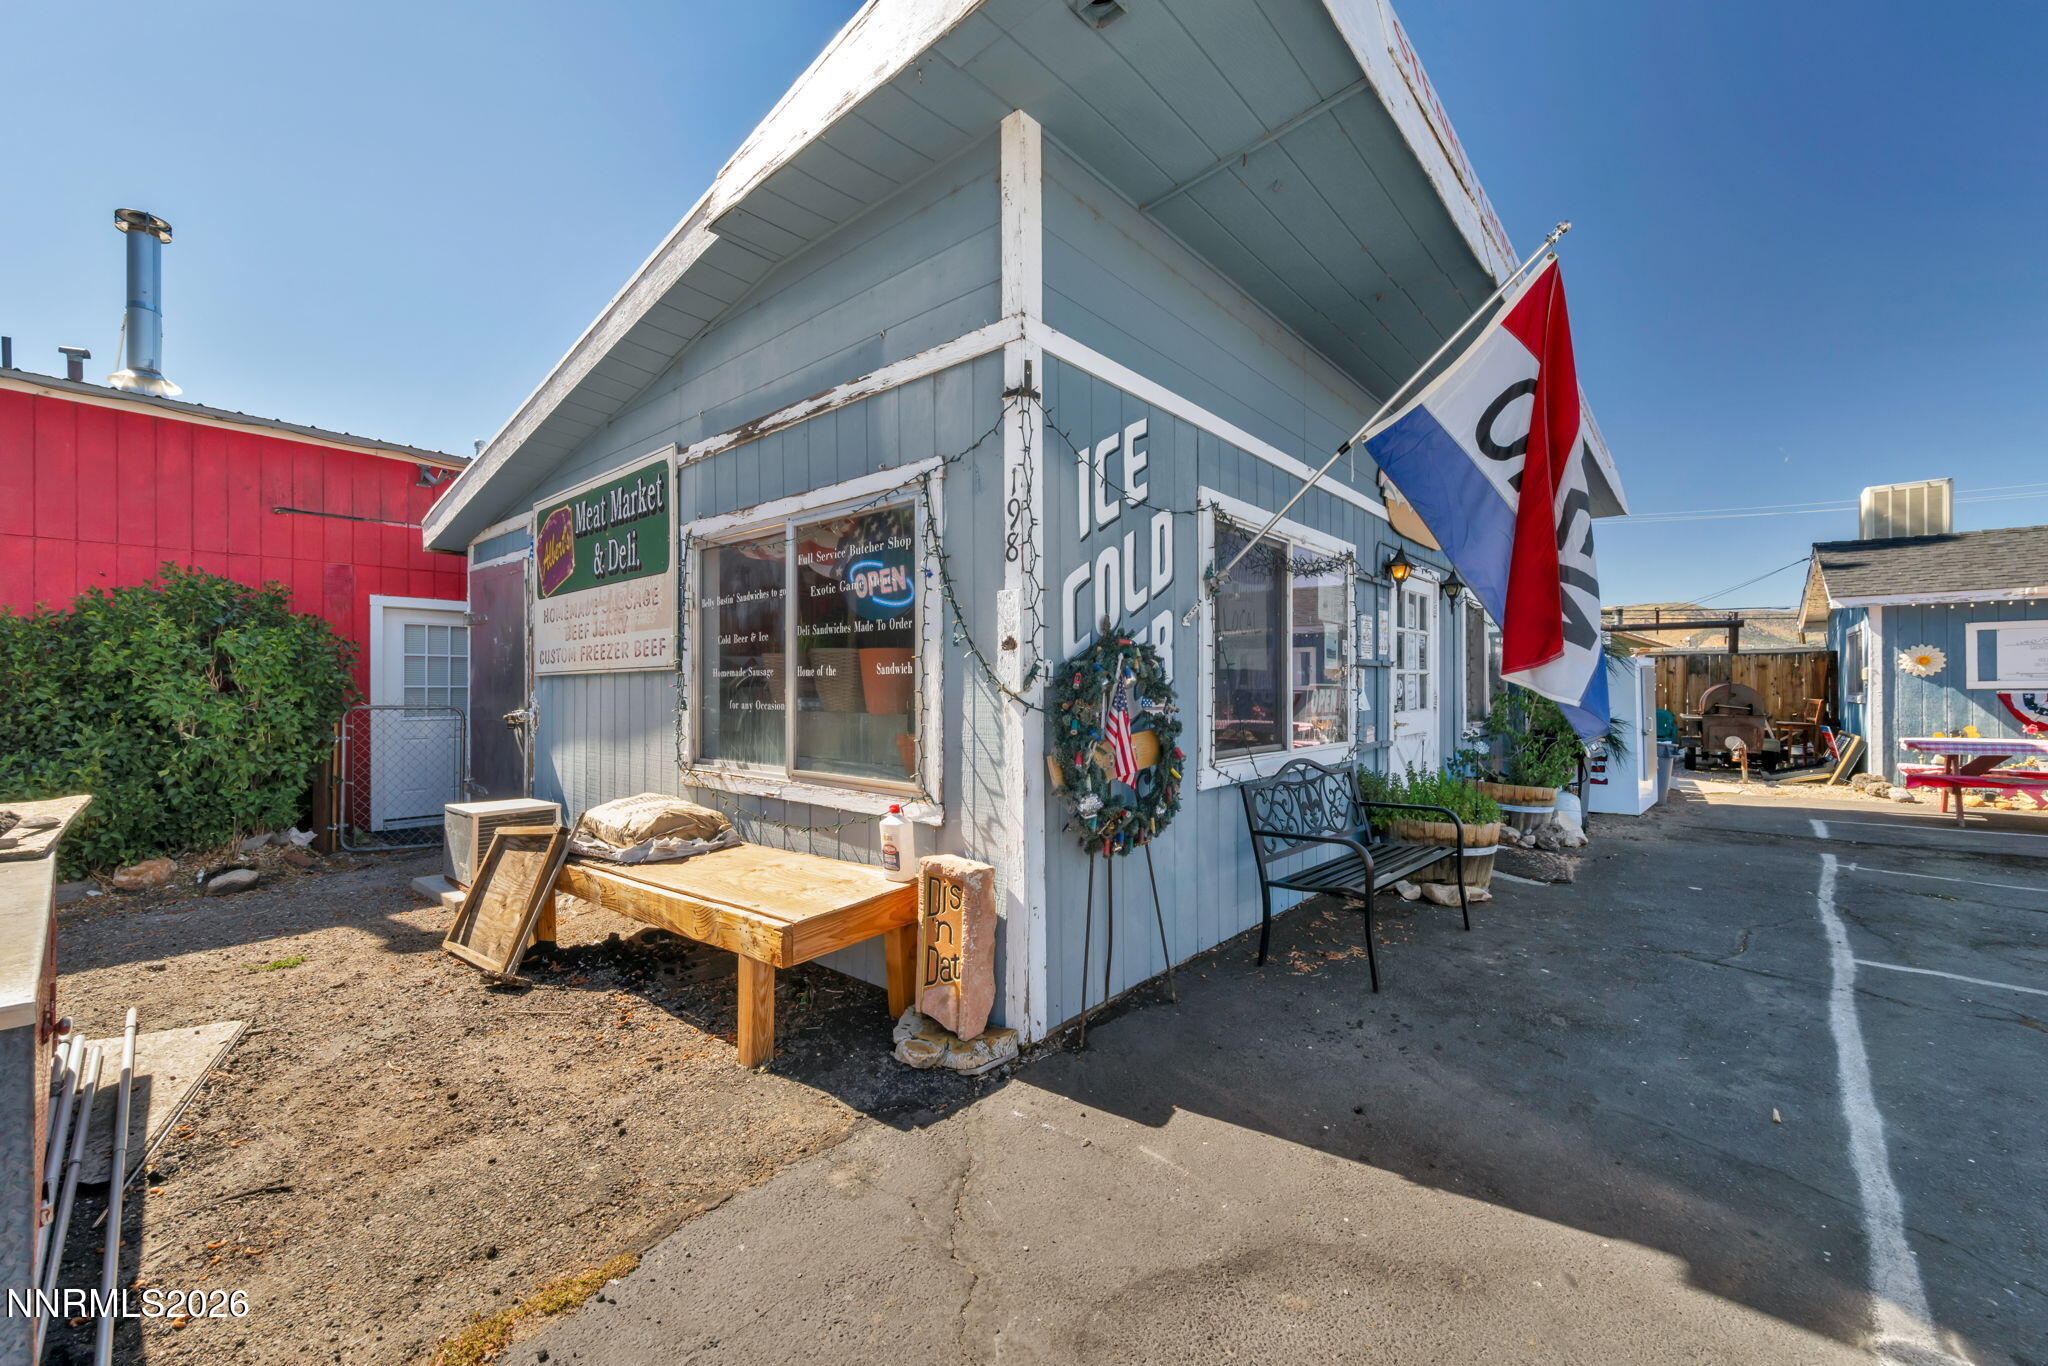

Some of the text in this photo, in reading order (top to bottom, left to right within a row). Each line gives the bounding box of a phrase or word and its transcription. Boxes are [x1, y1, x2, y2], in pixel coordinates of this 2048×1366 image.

[1077, 417, 1149, 541] ICE
[575, 473, 664, 535] Meat Market
[1005, 467, 1021, 562] 198
[593, 542, 604, 575] &
[797, 536, 912, 566] Full Service Butcher Shop
[810, 582, 836, 597] Exotic
[840, 580, 864, 592] Game
[855, 565, 907, 598] OPEN
[1062, 508, 1174, 662] COLD
[543, 597, 598, 624] HOMEMADE
[701, 597, 715, 609] Belly
[736, 588, 769, 603] Sandwiches
[771, 588, 778, 597] to
[564, 622, 590, 641] BEEF
[717, 631, 769, 645] Cold Beer & Ice
[797, 617, 913, 636] Deli Sandwiches Made To Order
[539, 637, 667, 666] CUSTOM FREEZER BEEF
[712, 667, 774, 679] Homemade Sausage
[797, 661, 913, 677] Home of the Sandwich
[729, 700, 786, 713] for any Occasion
[924, 945, 961, 987] Dat
